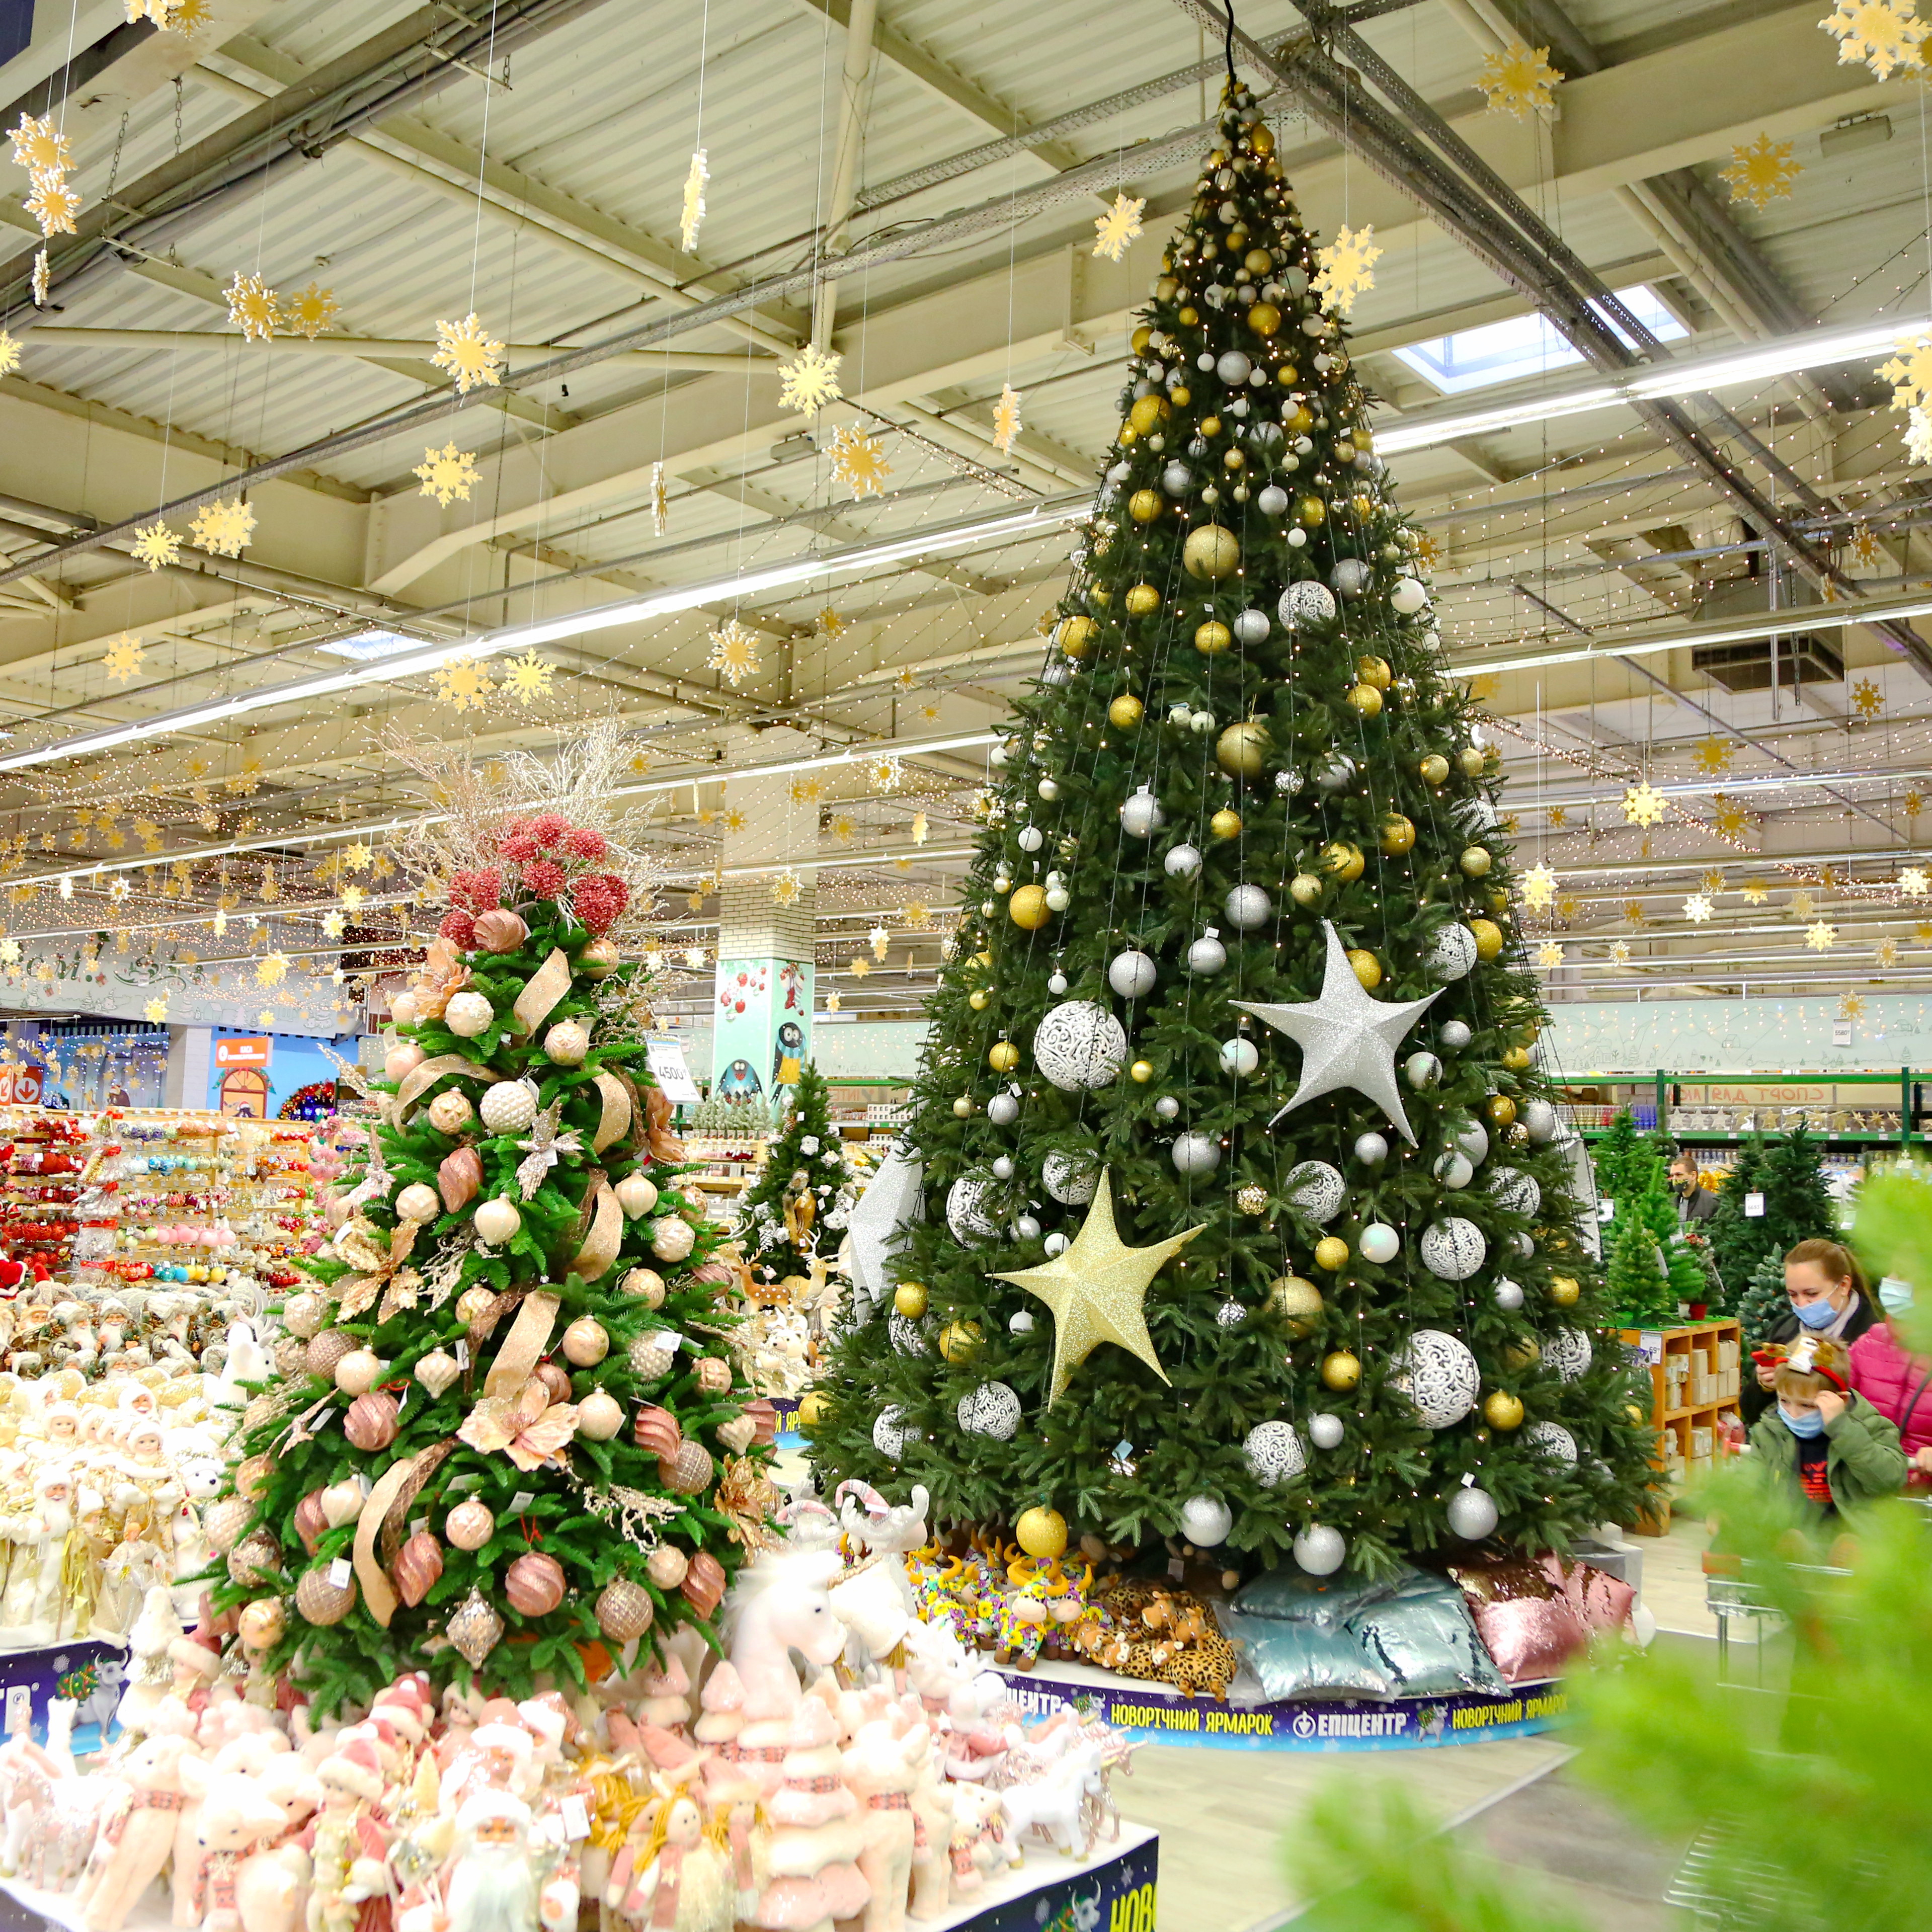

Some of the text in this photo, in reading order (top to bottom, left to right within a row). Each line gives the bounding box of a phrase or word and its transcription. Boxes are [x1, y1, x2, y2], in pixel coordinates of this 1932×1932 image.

[1111, 1703, 1273, 1735] НОВОРІЧНИЙ ЯРМАРОК
[1318, 1712, 1407, 1738] ЕПІЦЕНТР
[1453, 1698, 1522, 1730] НОВОРІЧНИЙ
